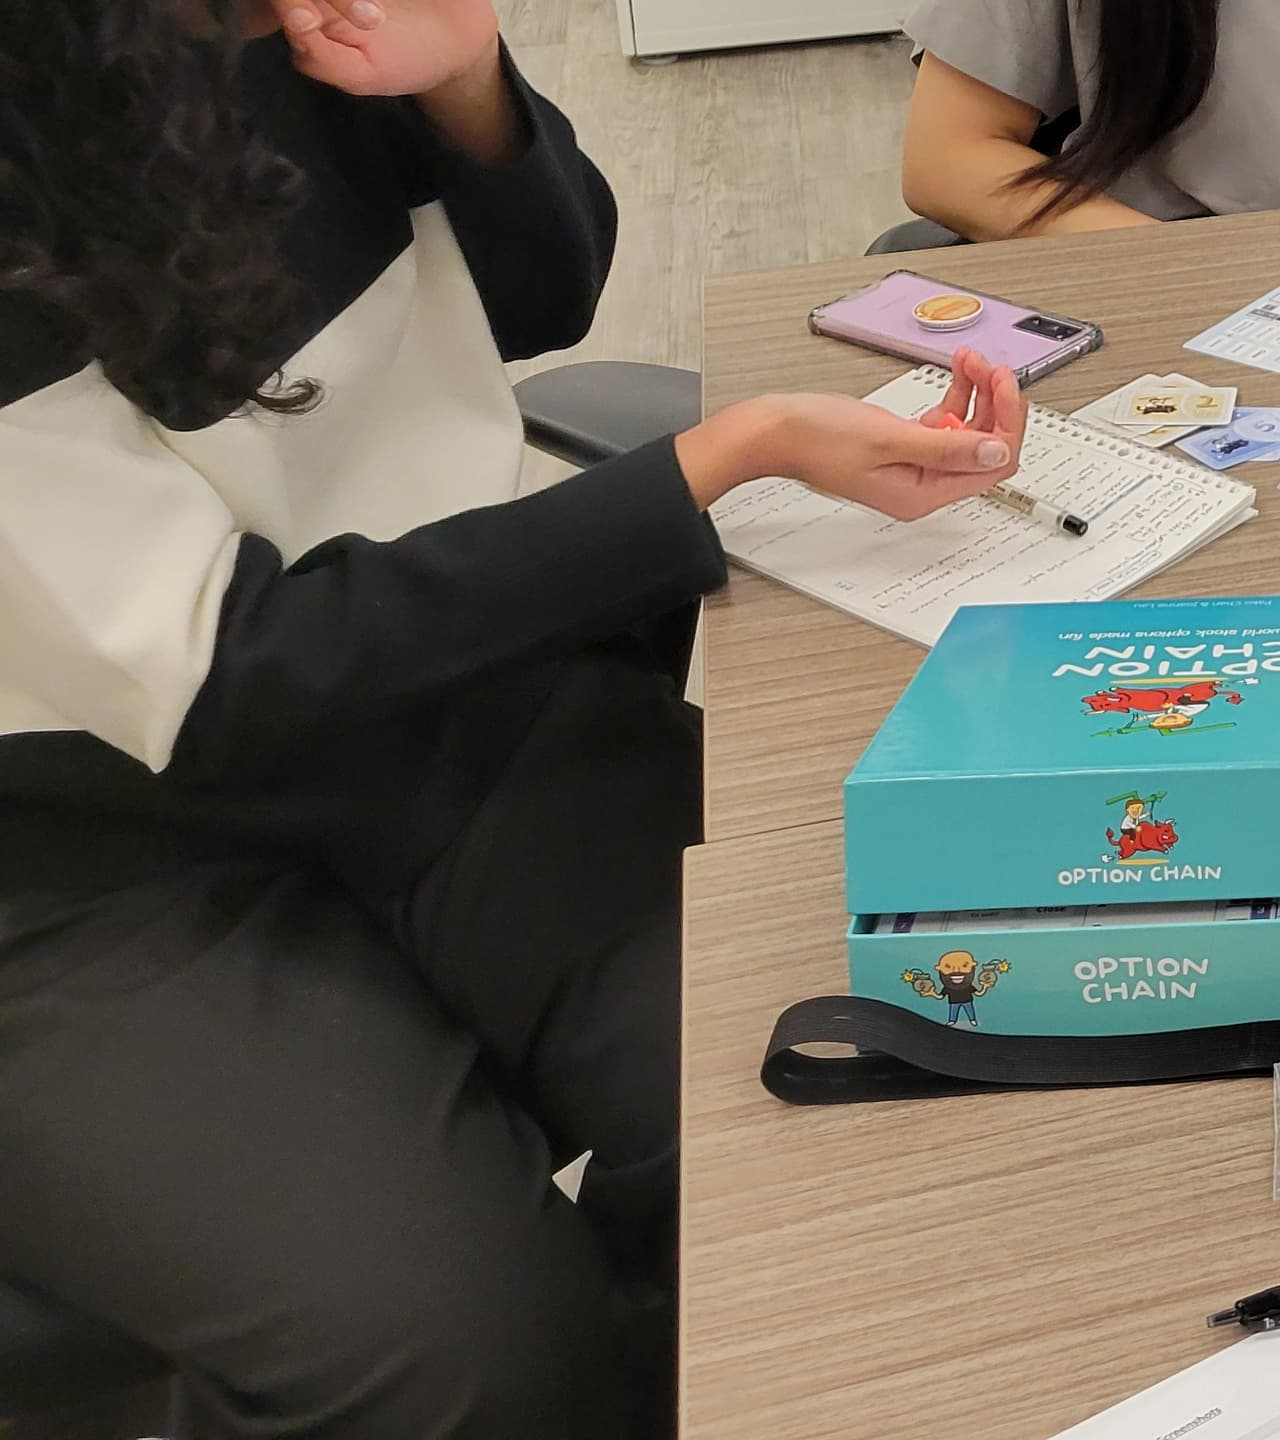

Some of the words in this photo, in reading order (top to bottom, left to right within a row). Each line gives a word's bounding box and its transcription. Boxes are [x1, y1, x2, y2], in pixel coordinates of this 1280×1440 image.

[1059, 632, 1083, 640] fun
[1089, 631, 1130, 639] made
[1136, 629, 1190, 638] options
[1196, 629, 1236, 637] stock
[1057, 867, 1143, 886] OPTION
[1150, 864, 1222, 882] CHAIN
[1073, 956, 1209, 980] OPTION
[1082, 980, 1198, 1004] CHAIN
